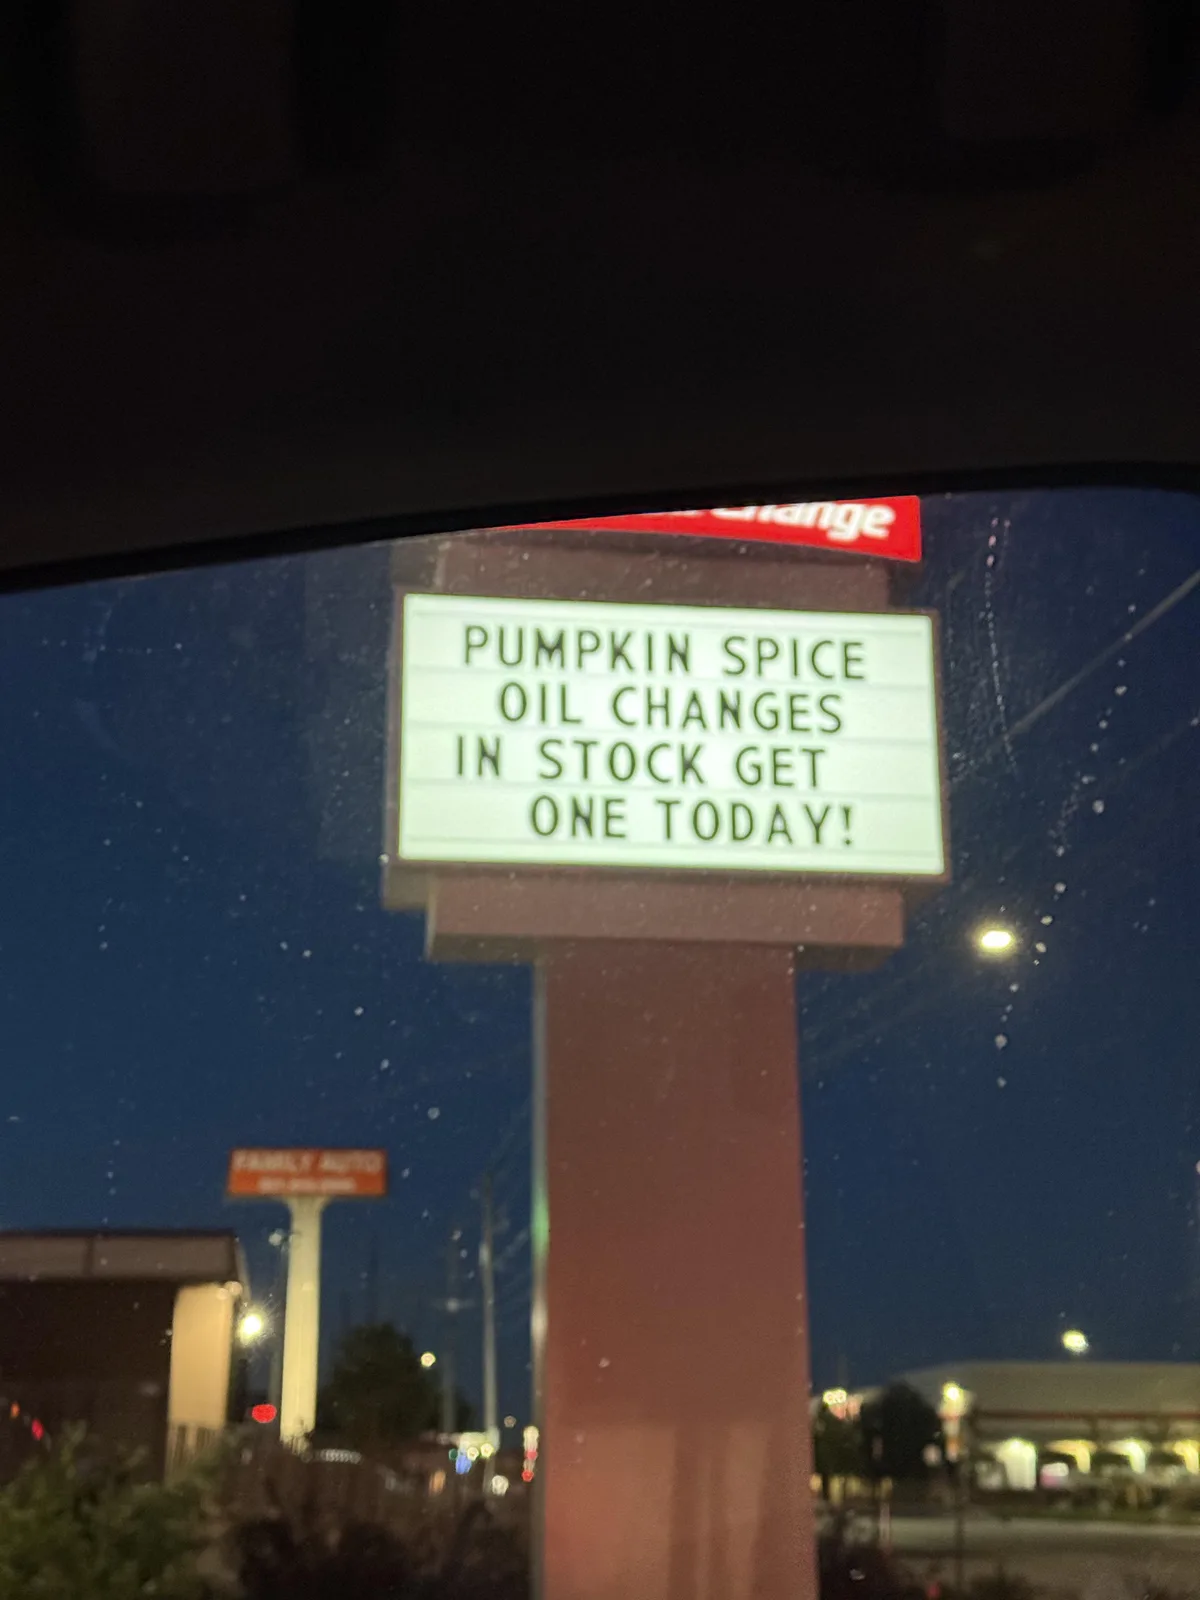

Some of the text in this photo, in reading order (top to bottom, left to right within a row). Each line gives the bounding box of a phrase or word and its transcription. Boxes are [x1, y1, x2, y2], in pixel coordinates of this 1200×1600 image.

[464, 624, 866, 680] PUMPKIN SPICE
[499, 682, 843, 734] OIL CHANGES
[457, 736, 826, 788] IN STOCK GET
[531, 795, 853, 847] ONE TODAY!
